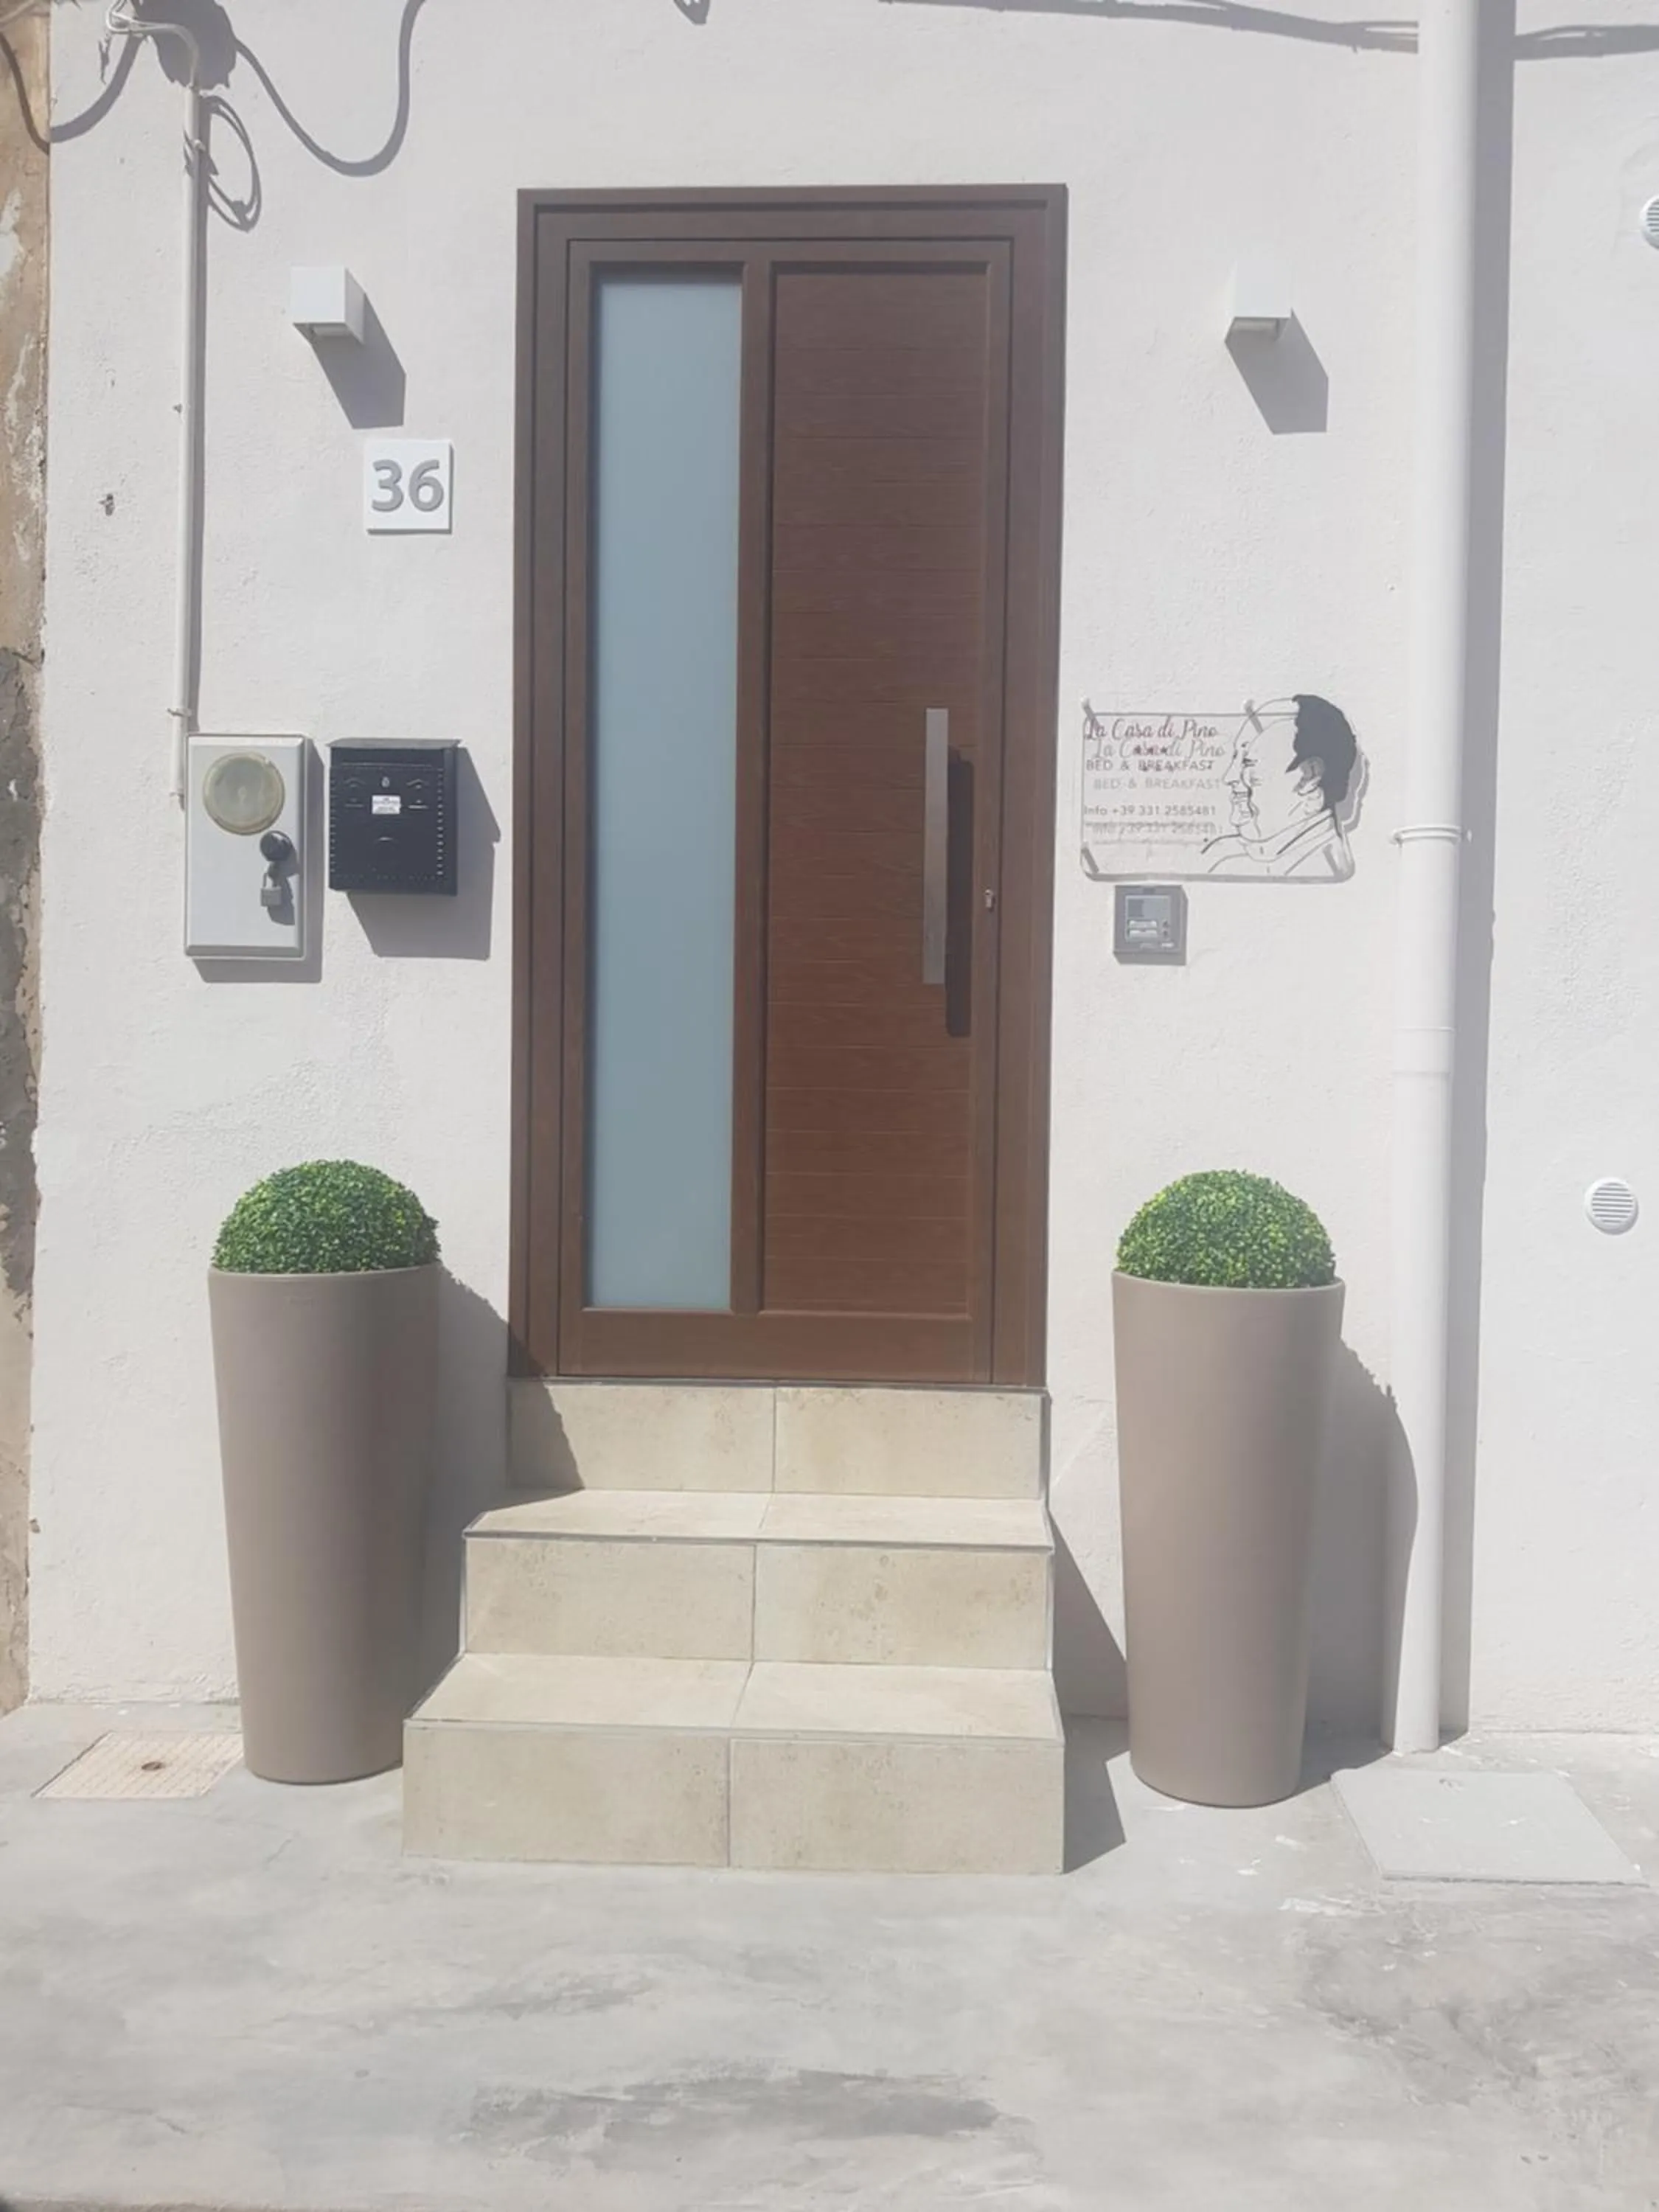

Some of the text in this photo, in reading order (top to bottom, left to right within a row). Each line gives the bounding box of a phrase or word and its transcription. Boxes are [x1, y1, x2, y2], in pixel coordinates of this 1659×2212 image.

[372, 459, 445, 512] 36
[1112, 718, 1152, 740] Casa
[1158, 716, 1175, 738] di
[1175, 718, 1218, 740] Pino
[1085, 759, 1113, 771] BED
[1138, 759, 1215, 772] BREAKFAST
